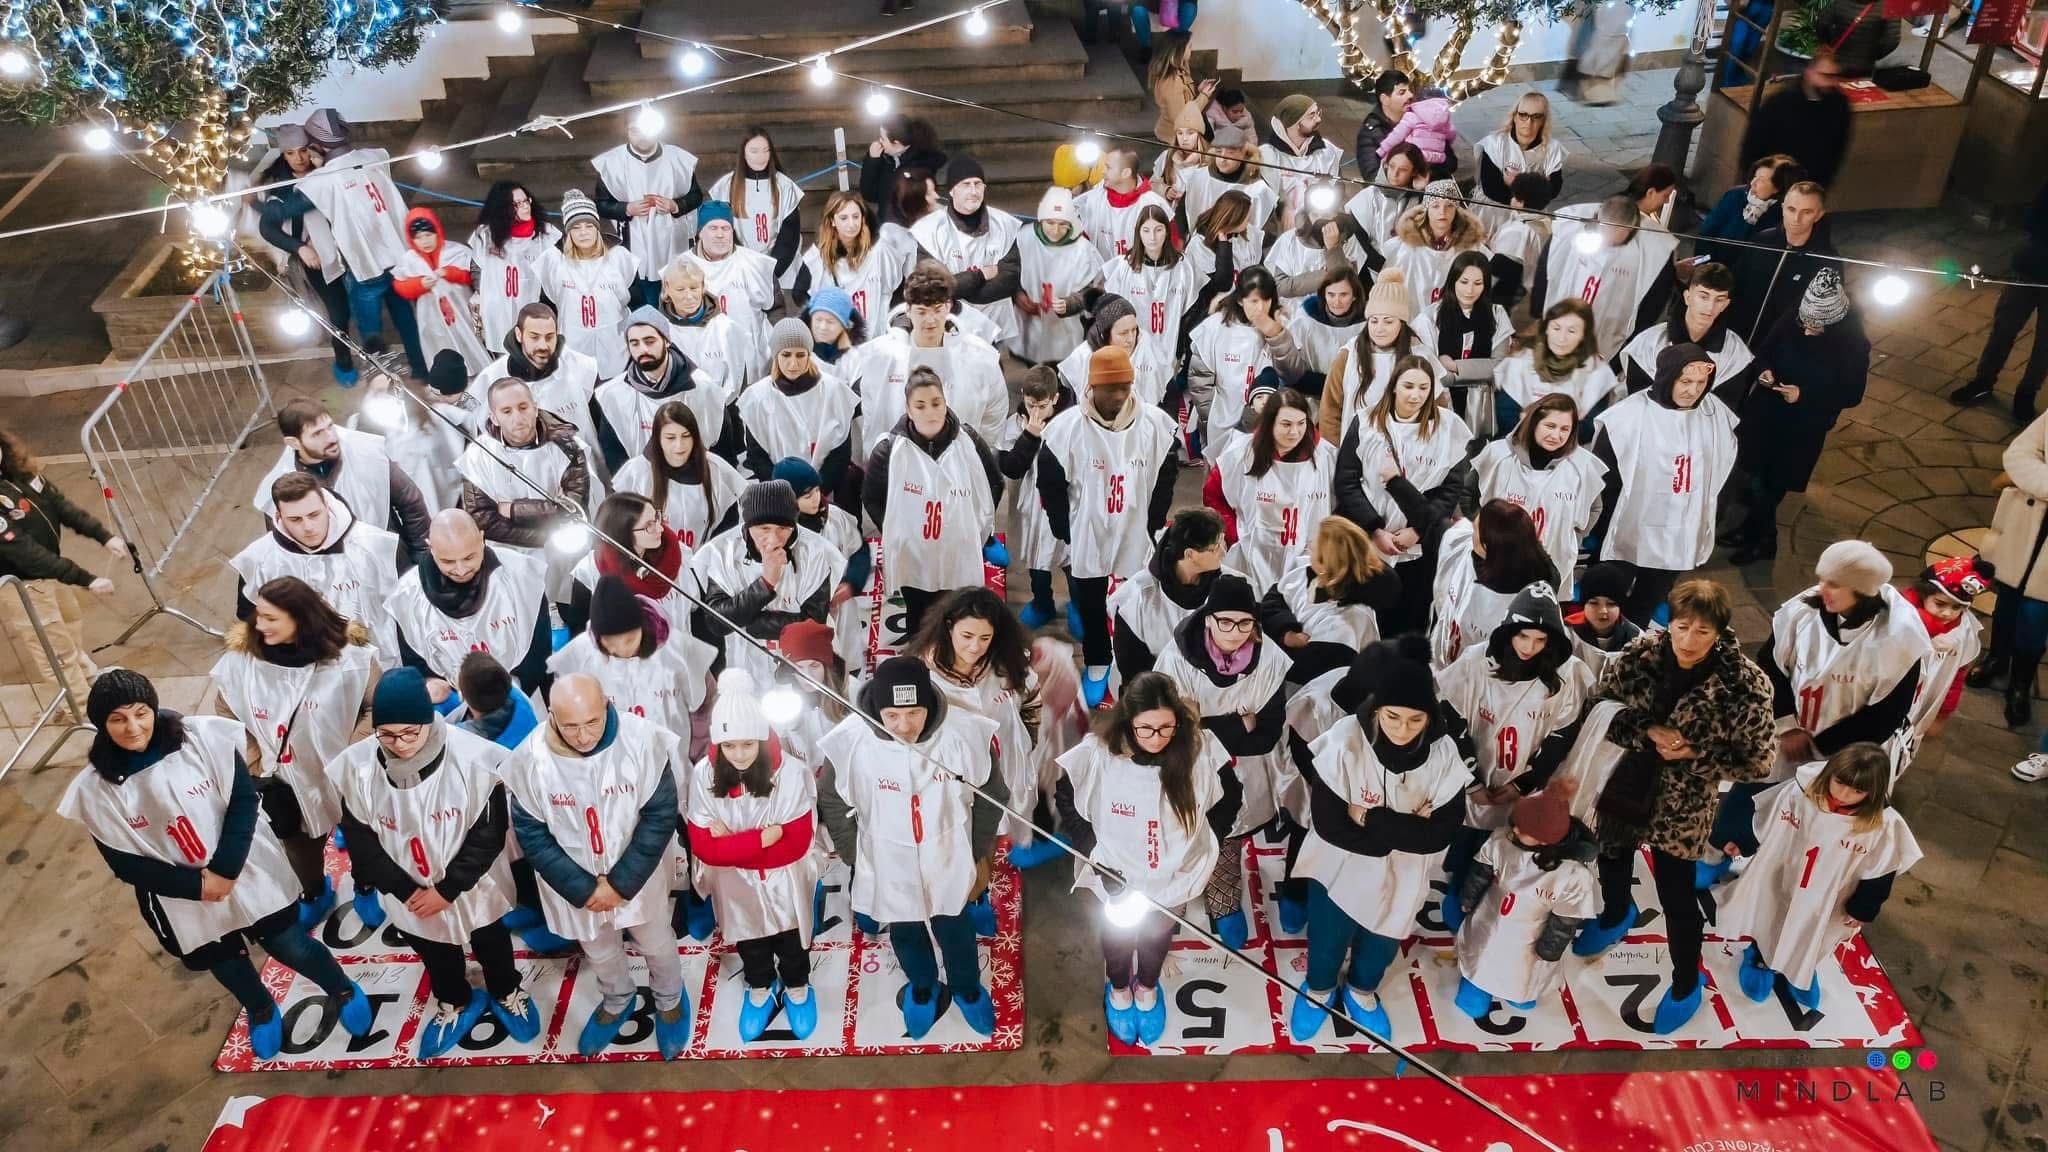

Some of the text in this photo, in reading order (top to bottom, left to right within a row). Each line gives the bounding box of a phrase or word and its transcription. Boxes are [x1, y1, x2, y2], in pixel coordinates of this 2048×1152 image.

[365, 182, 386, 213] 51
[506, 265, 518, 298] 80
[581, 295, 596, 328] 69
[1151, 302, 1165, 334] 65
[1673, 454, 1691, 493] 31
[1107, 474, 1124, 513] 35
[923, 501, 942, 540] 36
[1280, 507, 1298, 546] 34
[1531, 507, 1545, 540] 2
[1799, 685, 1824, 732] 11
[1496, 726, 1518, 771] 13
[911, 793, 924, 844] 6
[1111, 801, 1136, 811] VIVI
[166, 815, 208, 864] 10
[586, 806, 603, 855] 8
[409, 836, 430, 878] 9
[1800, 846, 1820, 889] 1
[1176, 979, 1227, 1039] 5
[1604, 974, 1661, 1033] 2
